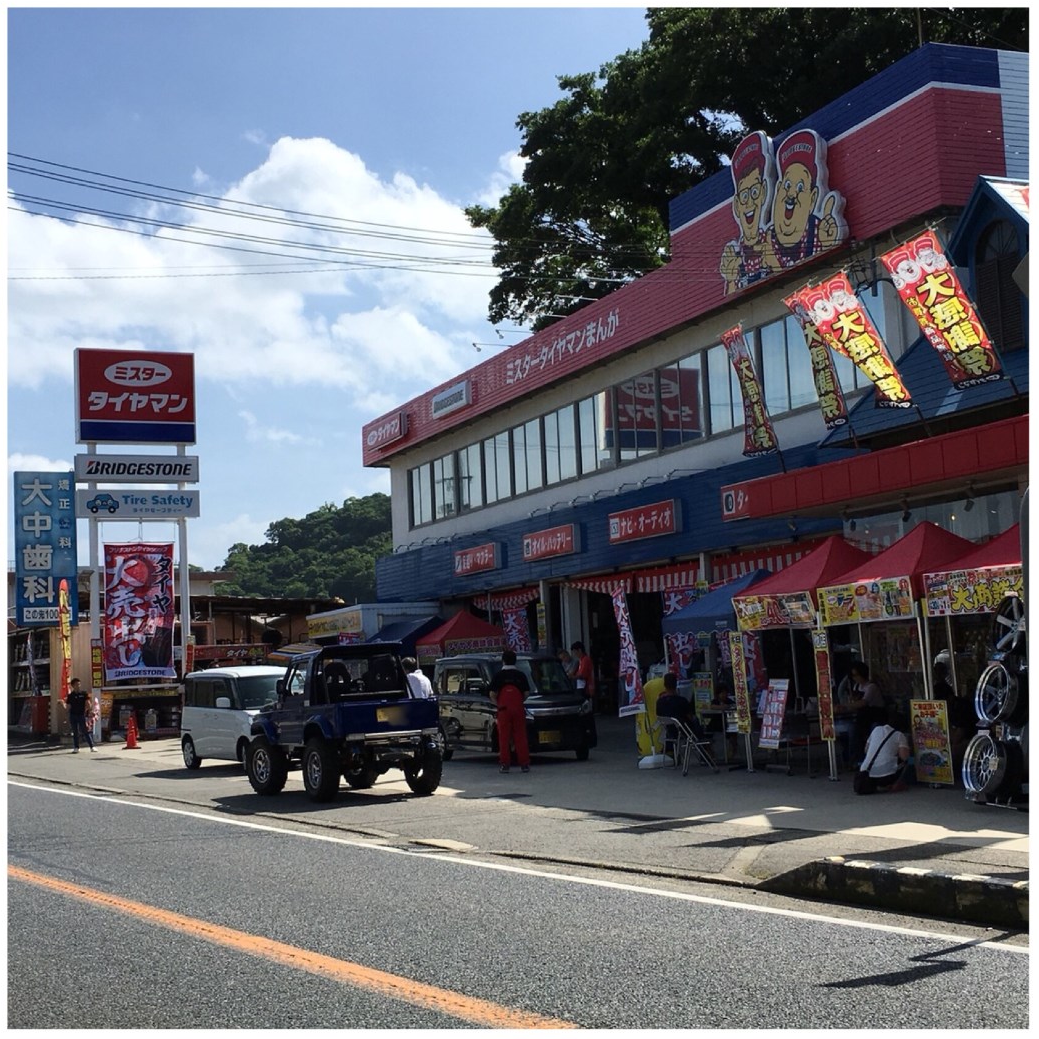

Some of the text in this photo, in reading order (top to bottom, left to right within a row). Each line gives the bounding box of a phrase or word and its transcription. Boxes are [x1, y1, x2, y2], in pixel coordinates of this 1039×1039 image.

[506, 308, 619, 384] ミスタータイヤマンまんが
[113, 367, 166, 380] ミスター
[88, 391, 188, 413] タイヤマン
[86, 461, 192, 476] BRIDGESTONE
[122, 495, 193, 508] Tire Safety
[737, 490, 748, 510] タ
[621, 509, 672, 536] ナビ・オーディオ
[21, 478, 55, 604] 大中歯科
[152, 555, 171, 613] タイヤ
[25, 608, 71, 620] この先100
[106, 556, 146, 667] 大売出し
[114, 669, 167, 678] BRIDGESTONE
